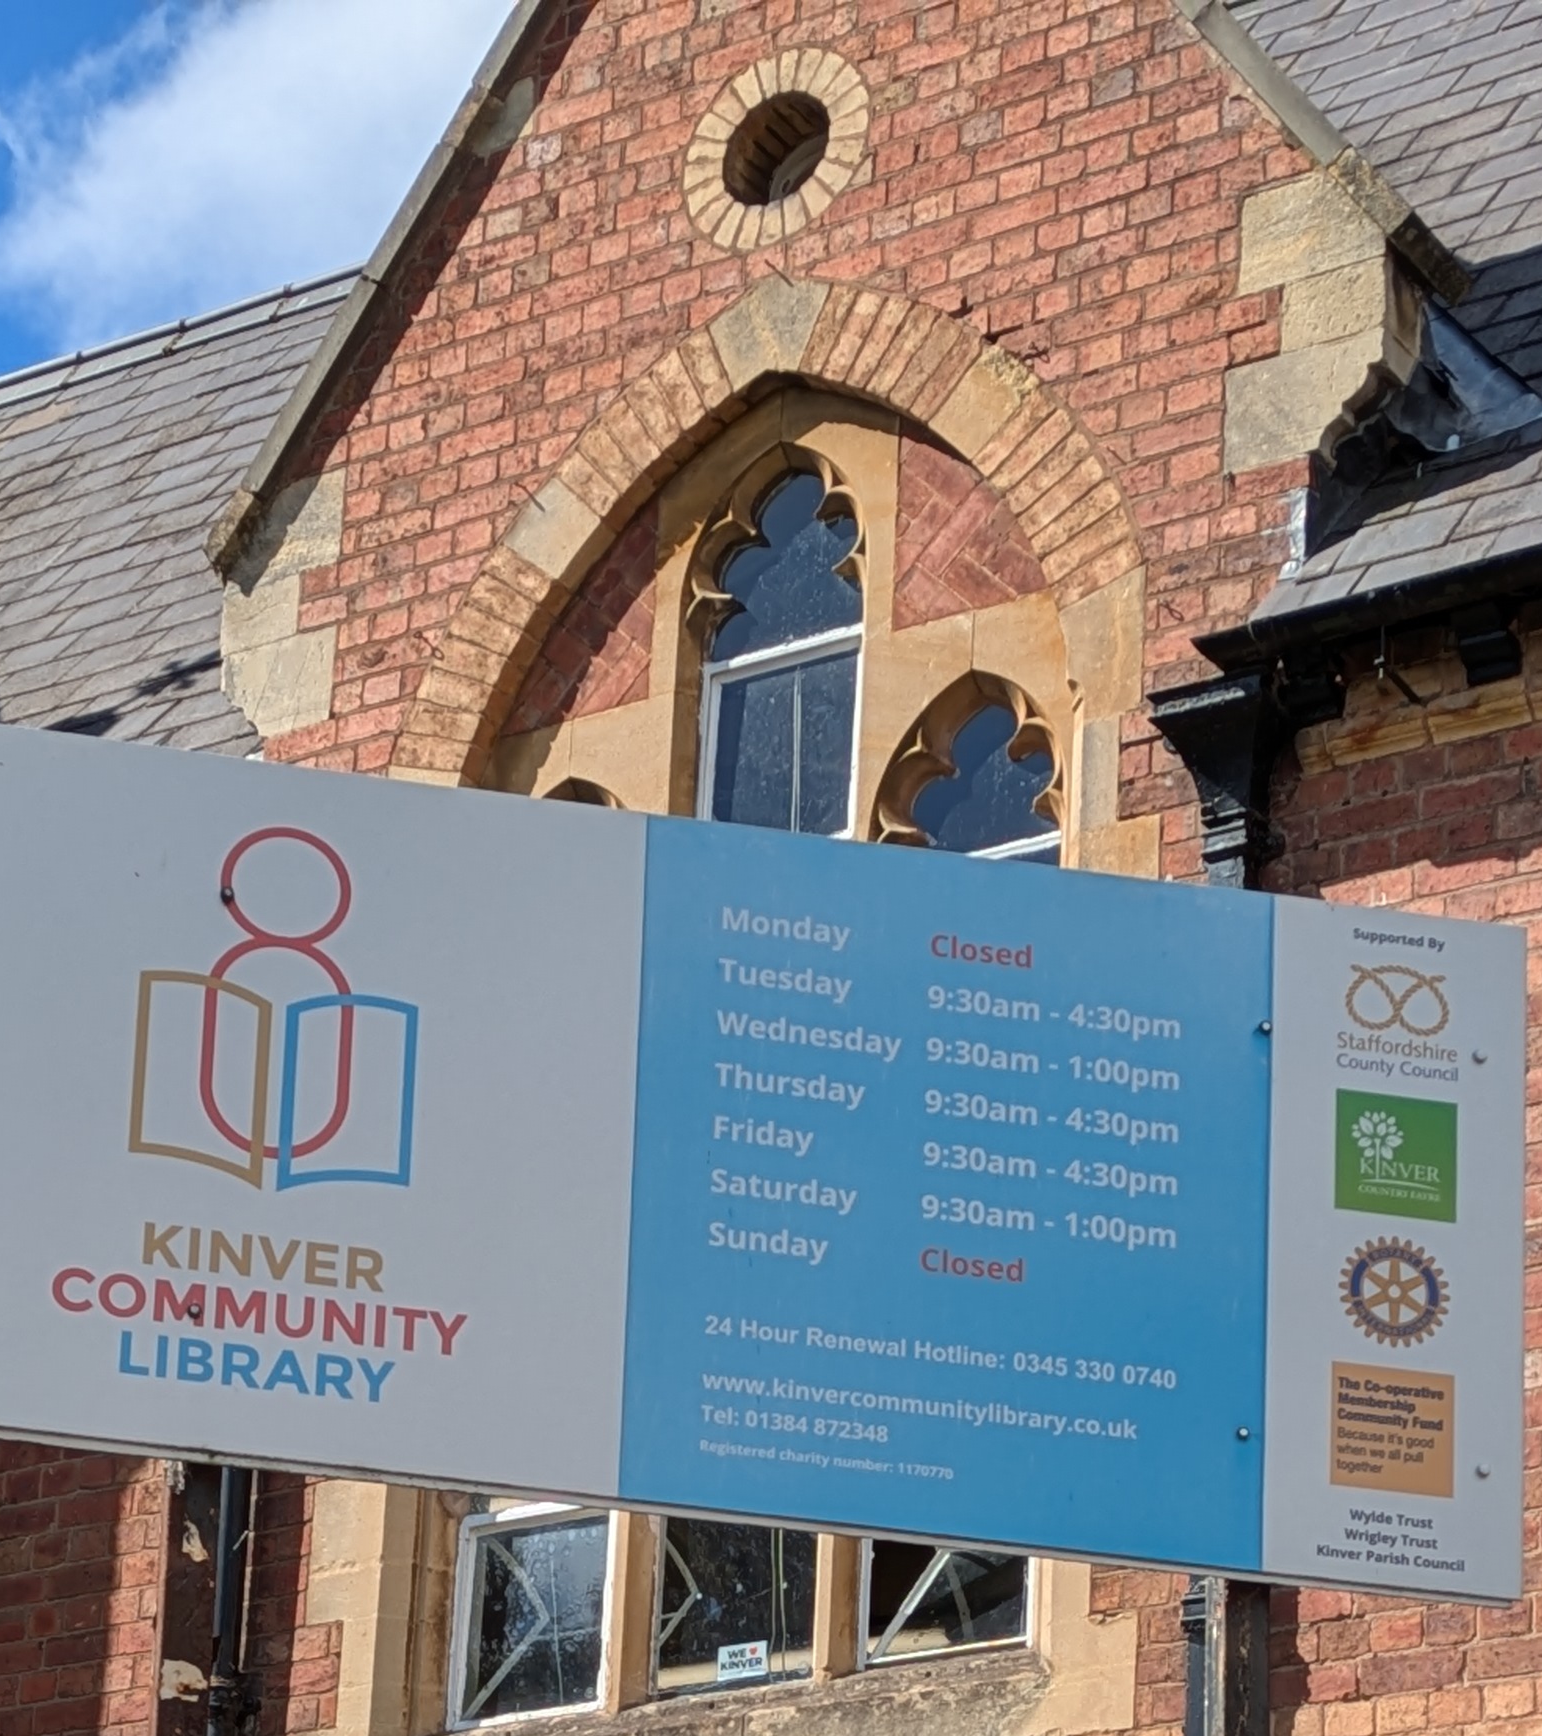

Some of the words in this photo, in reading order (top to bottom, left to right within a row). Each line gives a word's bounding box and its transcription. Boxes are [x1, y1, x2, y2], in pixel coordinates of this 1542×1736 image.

[721, 906, 850, 952] Monday
[930, 933, 1033, 969] Closed
[1353, 928, 1424, 947] Supported
[1428, 937, 1445, 952] By
[719, 958, 851, 1003] Tuesday
[928, 984, 1040, 1023] 9:30am
[1067, 1003, 1181, 1041] 4:30pm
[717, 1010, 902, 1063] Wednesday
[926, 1037, 1039, 1075] 9:30am
[1068, 1056, 1180, 1093] 1:00pm
[1337, 1032, 1458, 1062] Staffordshire
[1336, 1054, 1394, 1077] County
[1400, 1062, 1458, 1082] Council
[715, 1063, 865, 1110] Thursday
[924, 1089, 1038, 1126] 9:30am
[1064, 1108, 1179, 1145] 4:30pm
[712, 1116, 814, 1157] Friday
[923, 1141, 1036, 1179] 9:30am
[1064, 1159, 1178, 1197] 4:30pm
[1360, 1158, 1441, 1183] KINVER
[711, 1169, 857, 1216] Saturday
[921, 1195, 1035, 1232] 9:30am
[1064, 1212, 1177, 1251] 1:00pm
[141, 1221, 384, 1292] KINVER
[709, 1222, 829, 1266] Sunday
[920, 1249, 1025, 1282] Closed
[51, 1266, 468, 1356] COMMUNITY
[118, 1330, 396, 1403] LIBRARY
[705, 1315, 734, 1337] 24
[740, 1319, 799, 1345] Hour
[806, 1327, 906, 1359] Renewal
[914, 1341, 1005, 1371] Hotline:
[1012, 1351, 1068, 1377] 0345
[1075, 1358, 1116, 1382] 330
[1122, 1365, 1177, 1390] 0740
[1338, 1376, 1360, 1390] The
[1364, 1379, 1444, 1401] Co-operative
[1338, 1392, 1415, 1414] Membership
[702, 1372, 1138, 1440] www.kinvercommunitylibrary.co.uk
[1338, 1408, 1408, 1429] Community
[1412, 1416, 1443, 1431] Fund
[701, 1404, 739, 1427] Tel:
[744, 1409, 809, 1436] 01384
[813, 1418, 889, 1444] 872348
[1337, 1426, 1384, 1442] Because
[1406, 1437, 1434, 1449] good
[700, 1439, 775, 1459] Registered
[779, 1449, 829, 1468] charity
[833, 1457, 893, 1473] number:
[897, 1462, 953, 1479] 1170770
[1337, 1443, 1366, 1456] when
[1369, 1449, 1385, 1459] we
[1388, 1449, 1401, 1460] all
[1404, 1452, 1424, 1463] pull
[1337, 1459, 1383, 1473] together
[1350, 1508, 1394, 1527] Wylde
[1397, 1513, 1433, 1530] Trust
[1344, 1528, 1397, 1548] Wrigley
[1402, 1534, 1438, 1550] Trust
[1316, 1544, 1362, 1563] Kinver
[1366, 1550, 1410, 1567] Parish
[1414, 1555, 1465, 1572] Council
[720, 1657, 762, 1671] KINVER
[727, 1648, 746, 1659] WE
